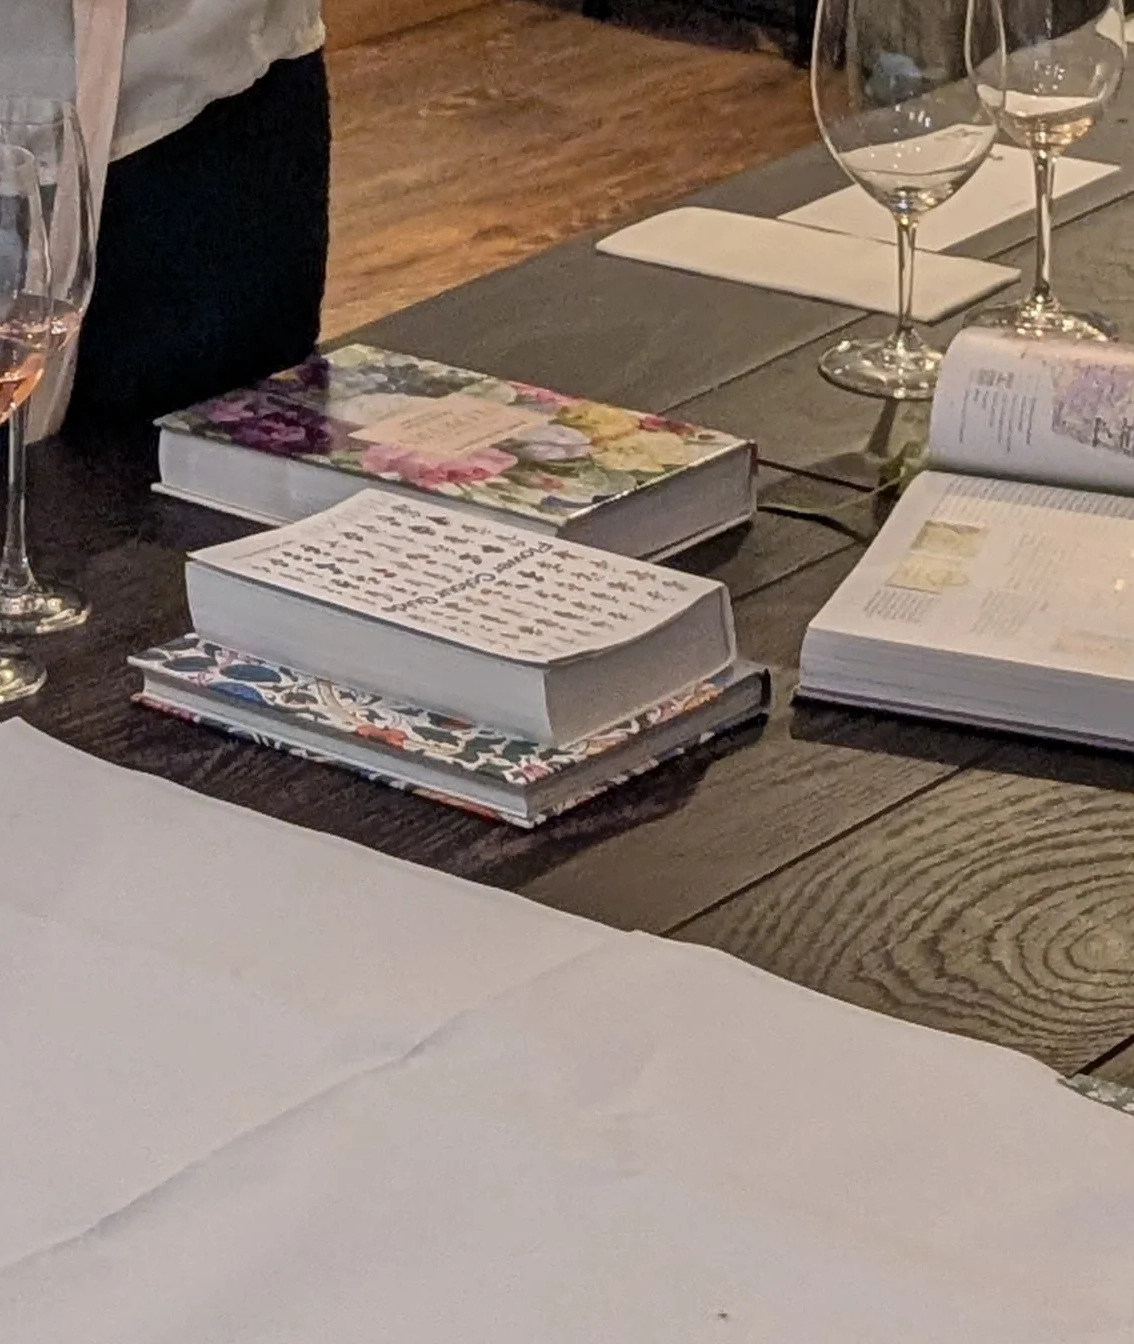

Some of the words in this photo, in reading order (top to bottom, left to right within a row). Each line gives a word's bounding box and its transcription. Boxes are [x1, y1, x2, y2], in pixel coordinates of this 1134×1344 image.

[493, 541, 554, 573] Flower
[434, 572, 497, 599] Colour
[381, 596, 439, 612] Guide
